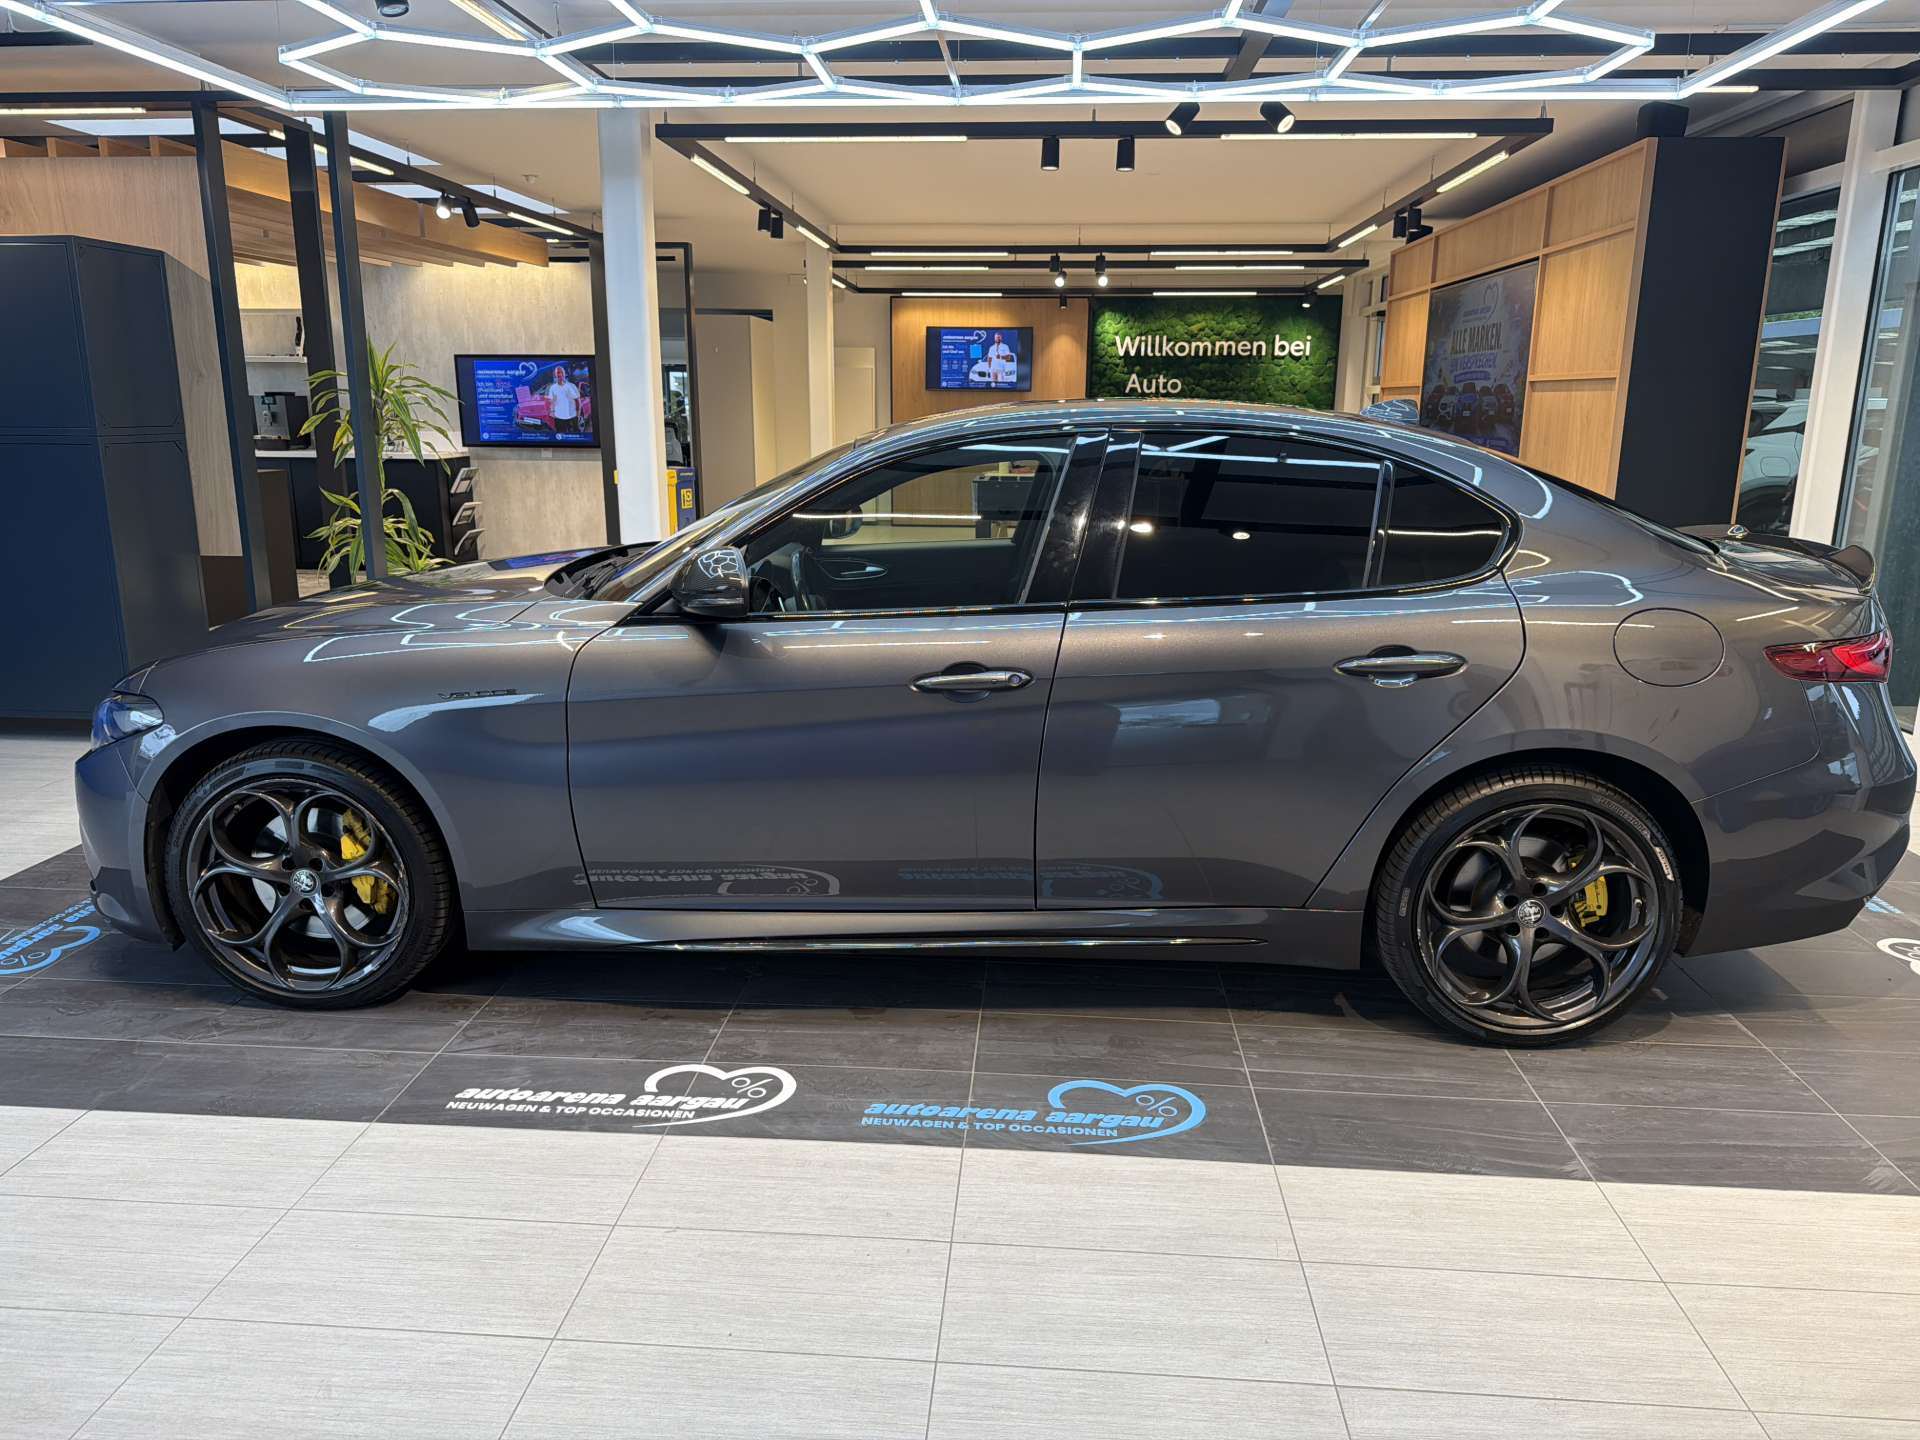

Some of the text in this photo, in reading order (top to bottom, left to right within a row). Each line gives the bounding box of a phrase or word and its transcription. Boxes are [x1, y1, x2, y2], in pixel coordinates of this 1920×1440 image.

[1115, 334, 1312, 357] Willkommen bei
[1125, 373, 1182, 394] Auto
[454, 1086, 751, 1110] autoarena aargau
[445, 1101, 696, 1119] NEUWAGEN & TOP OCCASIONEN
[863, 1101, 1167, 1130] autoarena aargau
[860, 1116, 1119, 1137] NEUWAGEN & TOP OCCASIONEN
